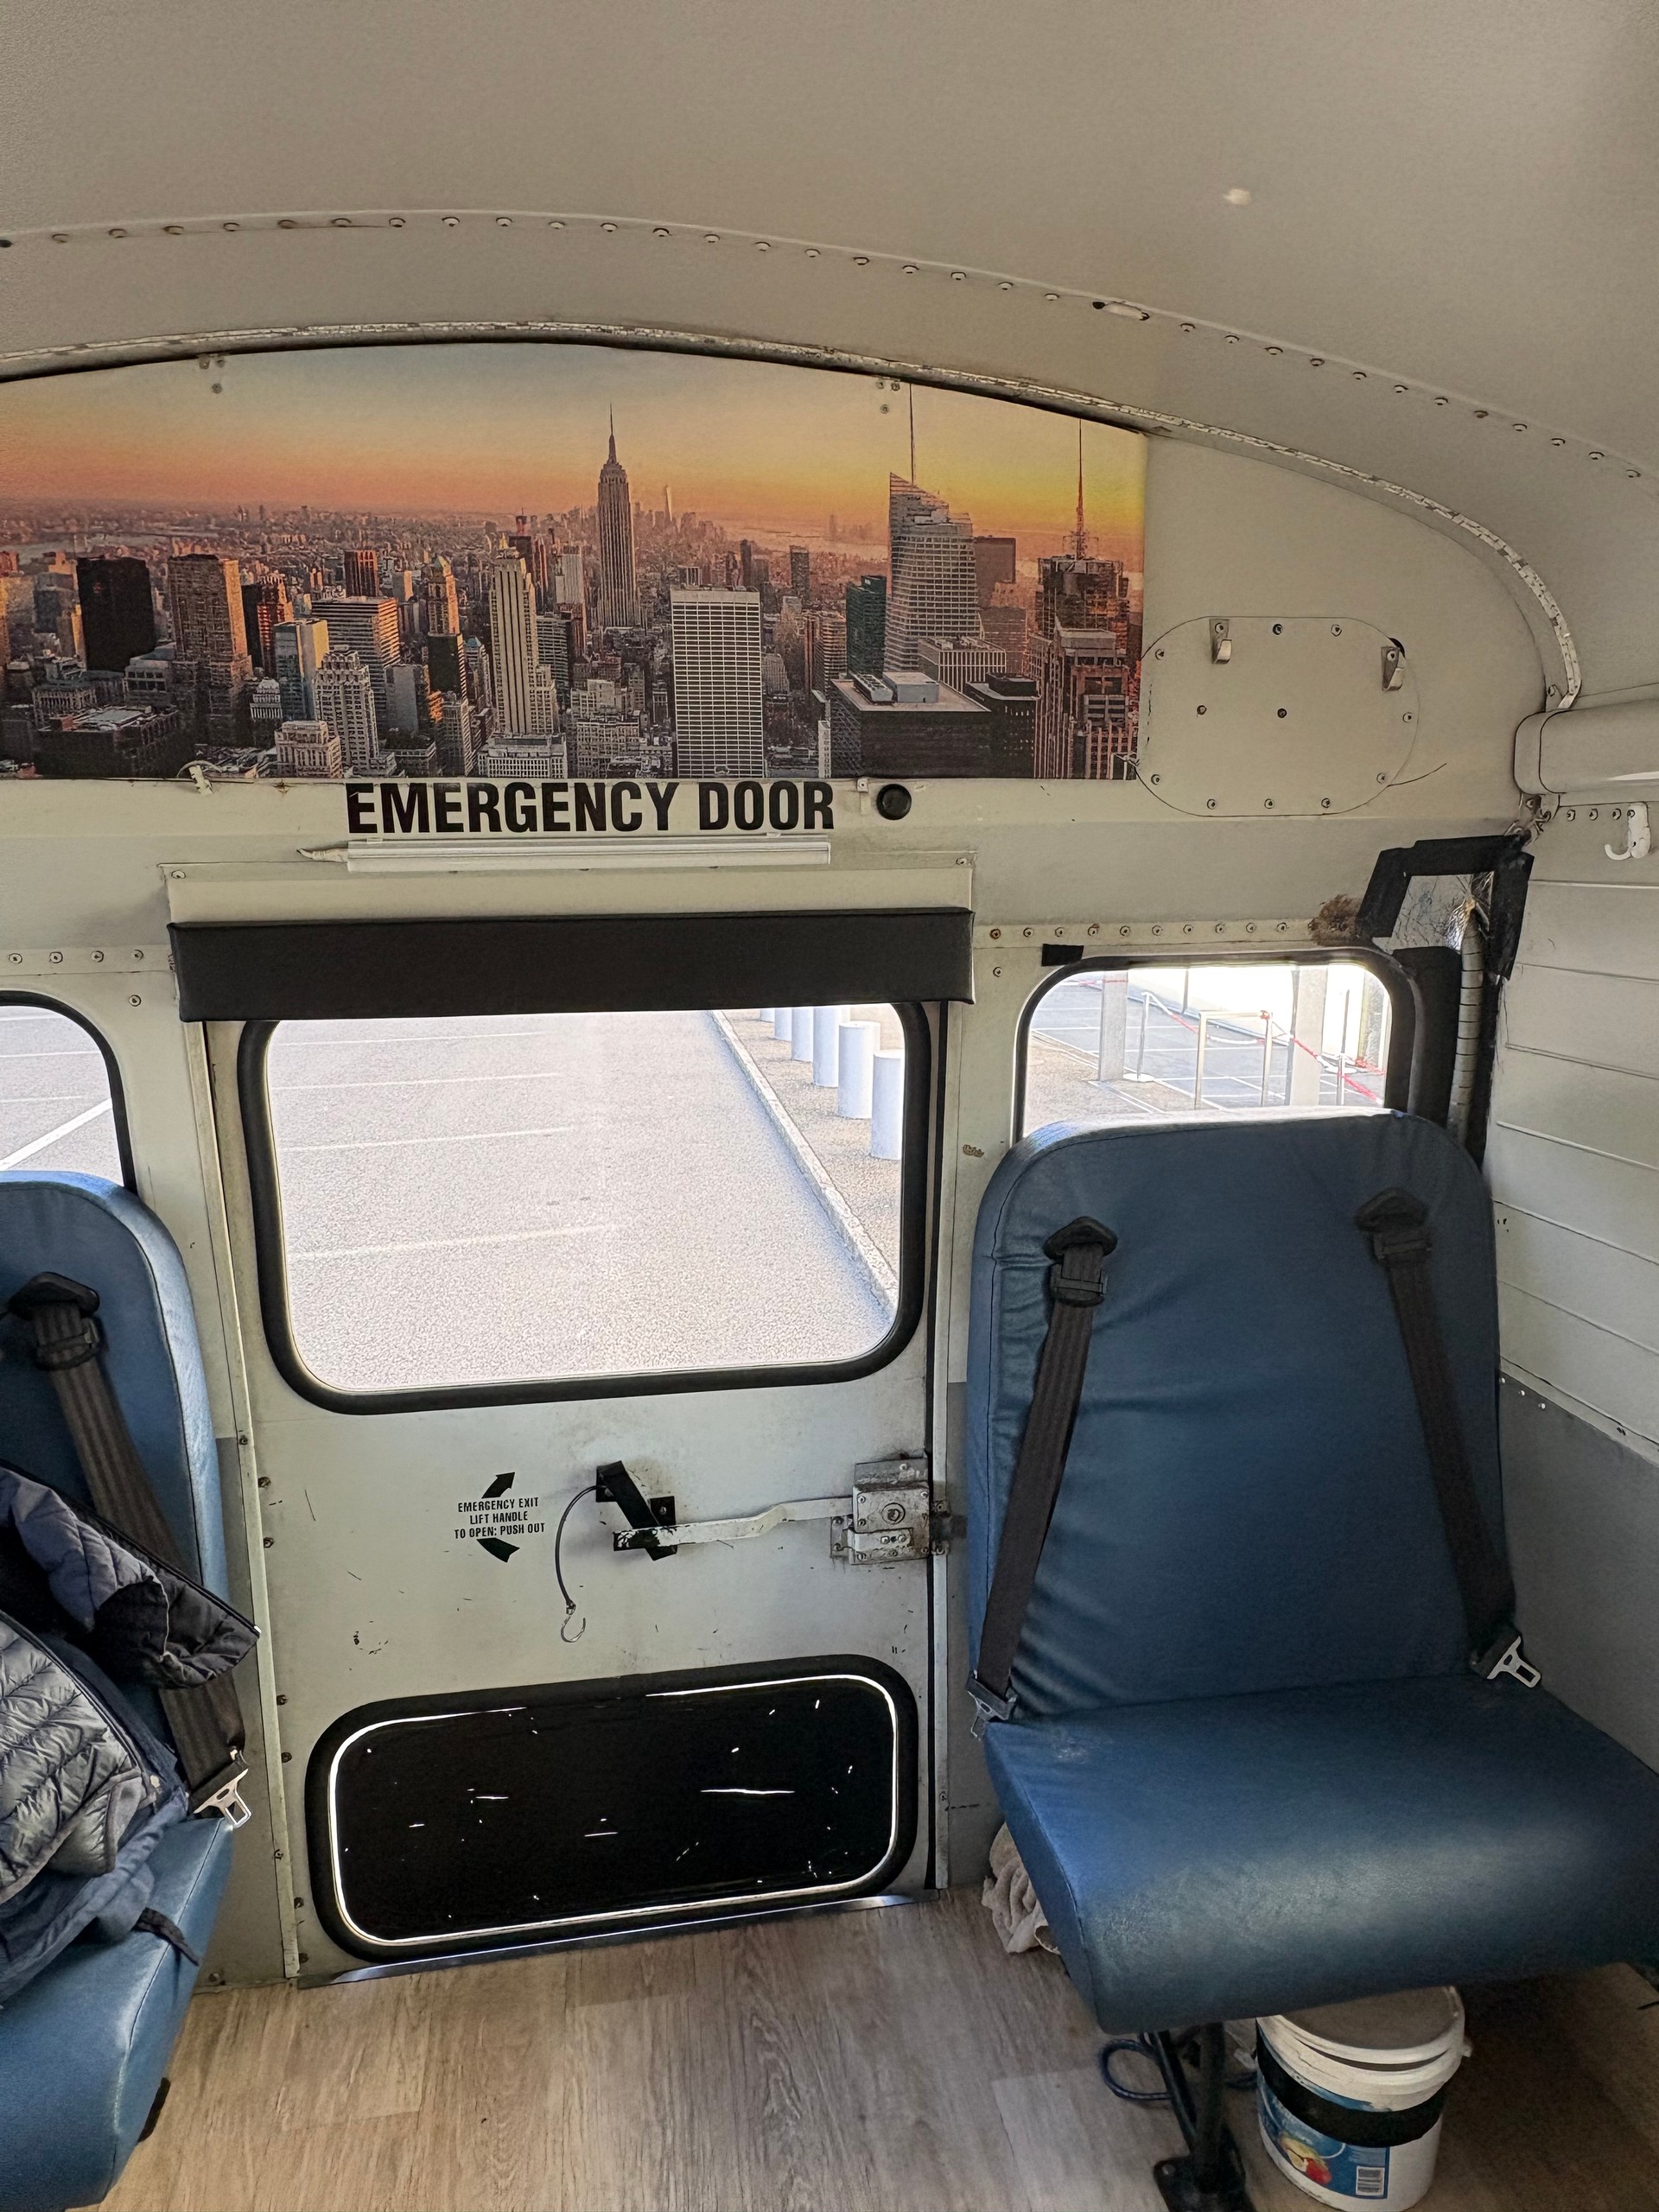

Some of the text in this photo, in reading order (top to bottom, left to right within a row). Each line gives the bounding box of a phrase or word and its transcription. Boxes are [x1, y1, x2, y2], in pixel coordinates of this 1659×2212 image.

[345, 780, 835, 834] EMERGENCY DOOR
[458, 1497, 539, 1513] EMERGENCY EXIT
[470, 1511, 528, 1525] LIFT HANDLE
[454, 1522, 545, 1539] TO OPEN: PUSH OUT
